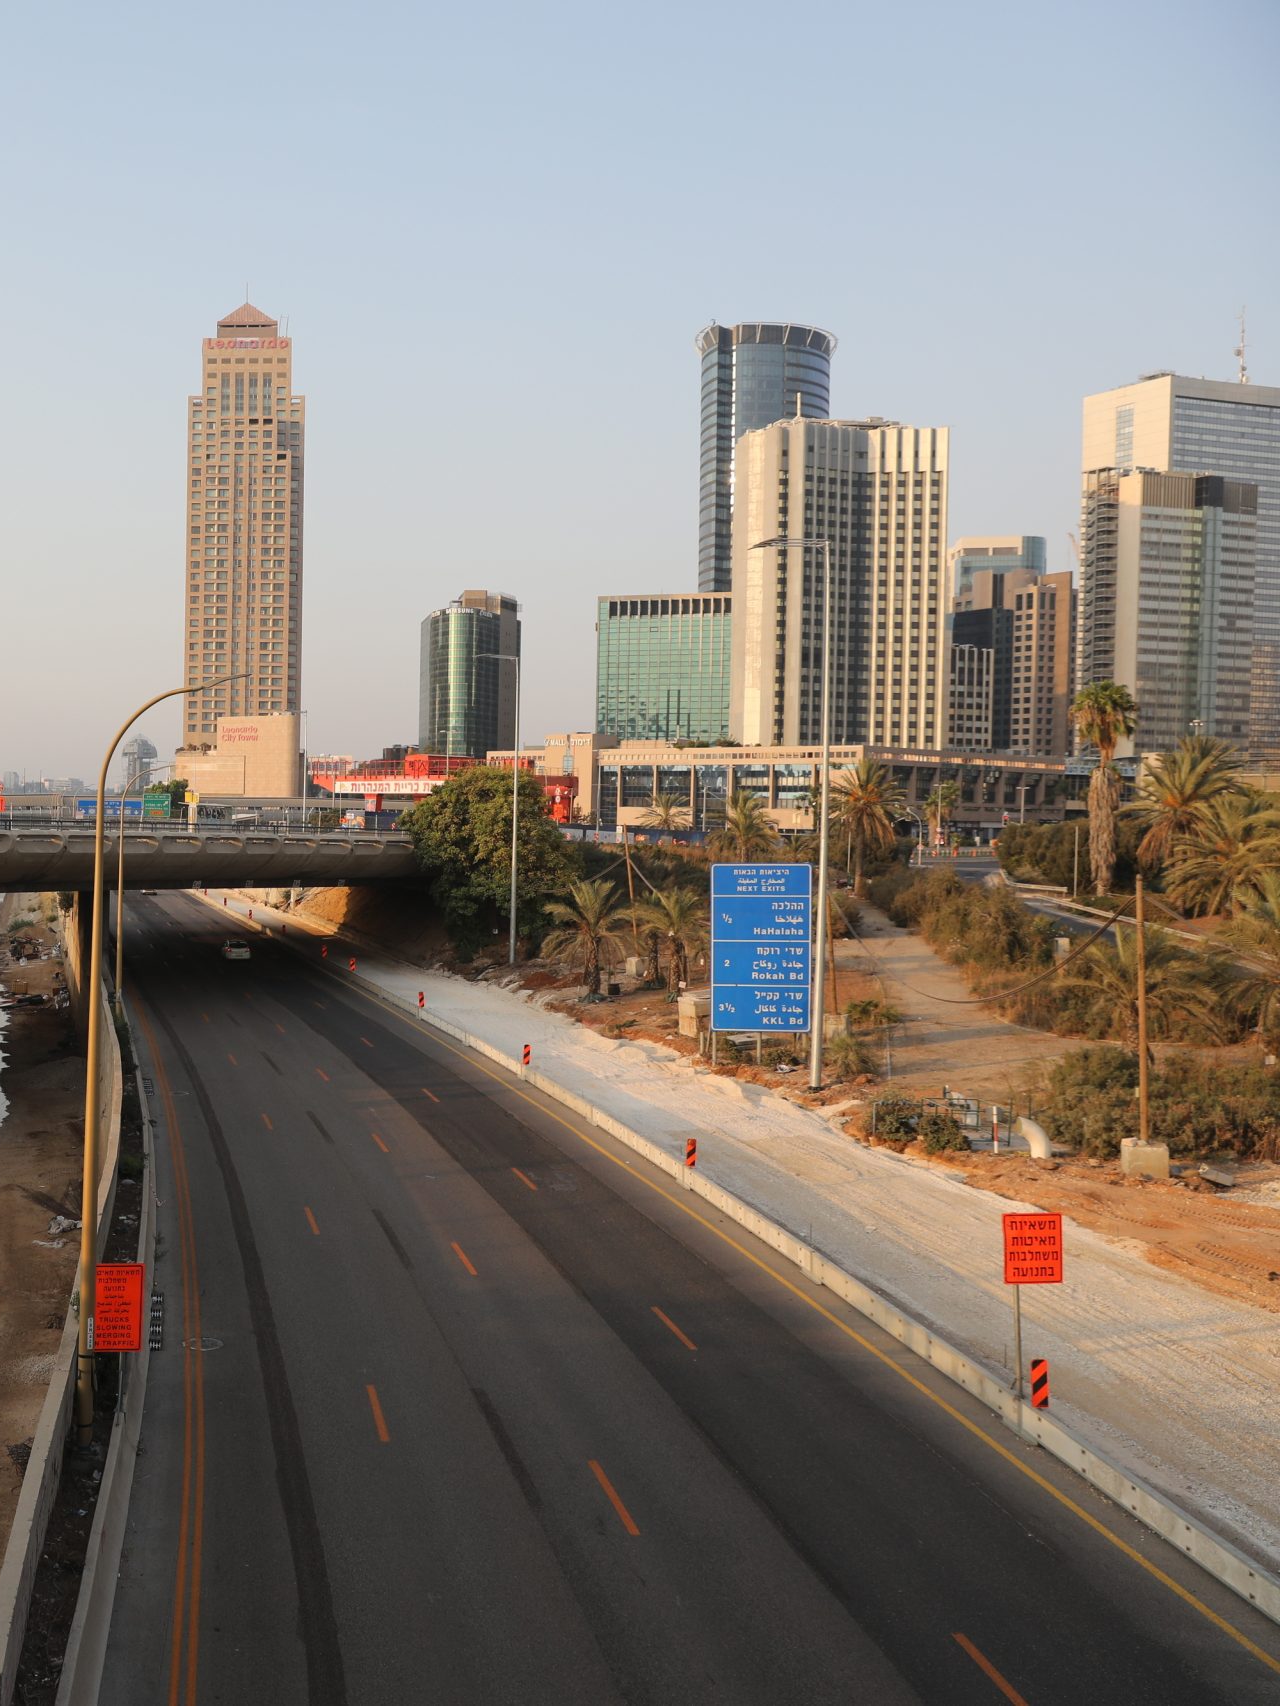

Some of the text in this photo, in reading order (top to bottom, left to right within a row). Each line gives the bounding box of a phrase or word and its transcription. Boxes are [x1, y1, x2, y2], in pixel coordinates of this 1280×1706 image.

[222, 734, 236, 742] City
[350, 782, 391, 792] המנהרות
[772, 901, 804, 910] ההלכה
[753, 927, 804, 935] HaHalaha
[756, 947, 780, 956] רוקח
[751, 972, 804, 980] Rokah Bd
[762, 1017, 803, 1025] KKL Bd
[1009, 1220, 1056, 1231] משאיות
[1011, 1236, 1056, 1246] מאיטות
[1009, 1250, 1058, 1261] משתלבות
[1013, 1266, 1055, 1277] בתנועה
